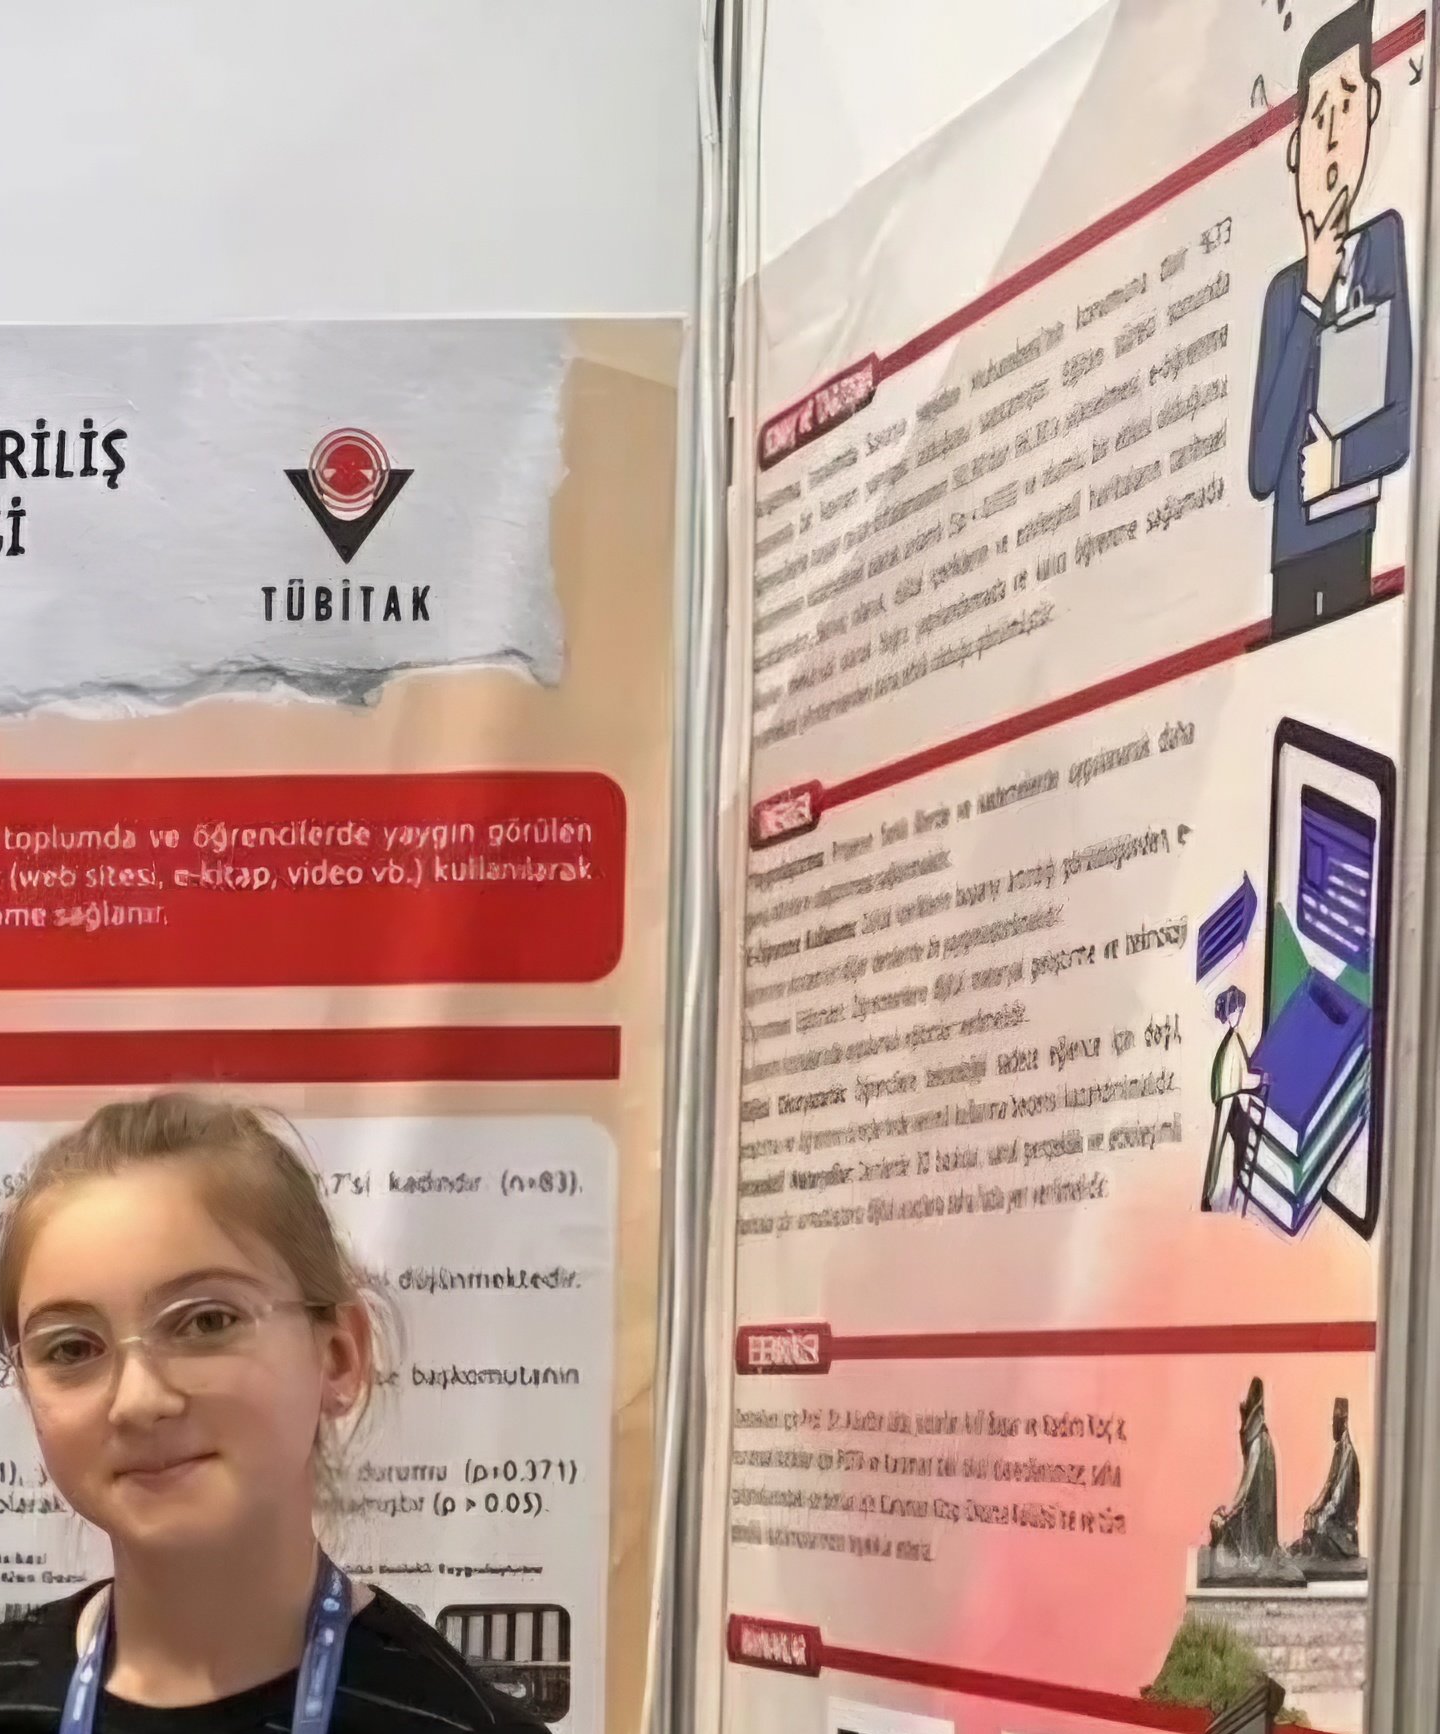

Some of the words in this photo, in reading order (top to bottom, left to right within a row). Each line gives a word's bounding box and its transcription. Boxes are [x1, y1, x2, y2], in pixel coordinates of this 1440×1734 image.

[260, 578, 432, 622] TÜBİTAK
[3, 824, 136, 858] toplumda
[192, 821, 371, 857] öğrencilerde
[286, 861, 365, 887] video
